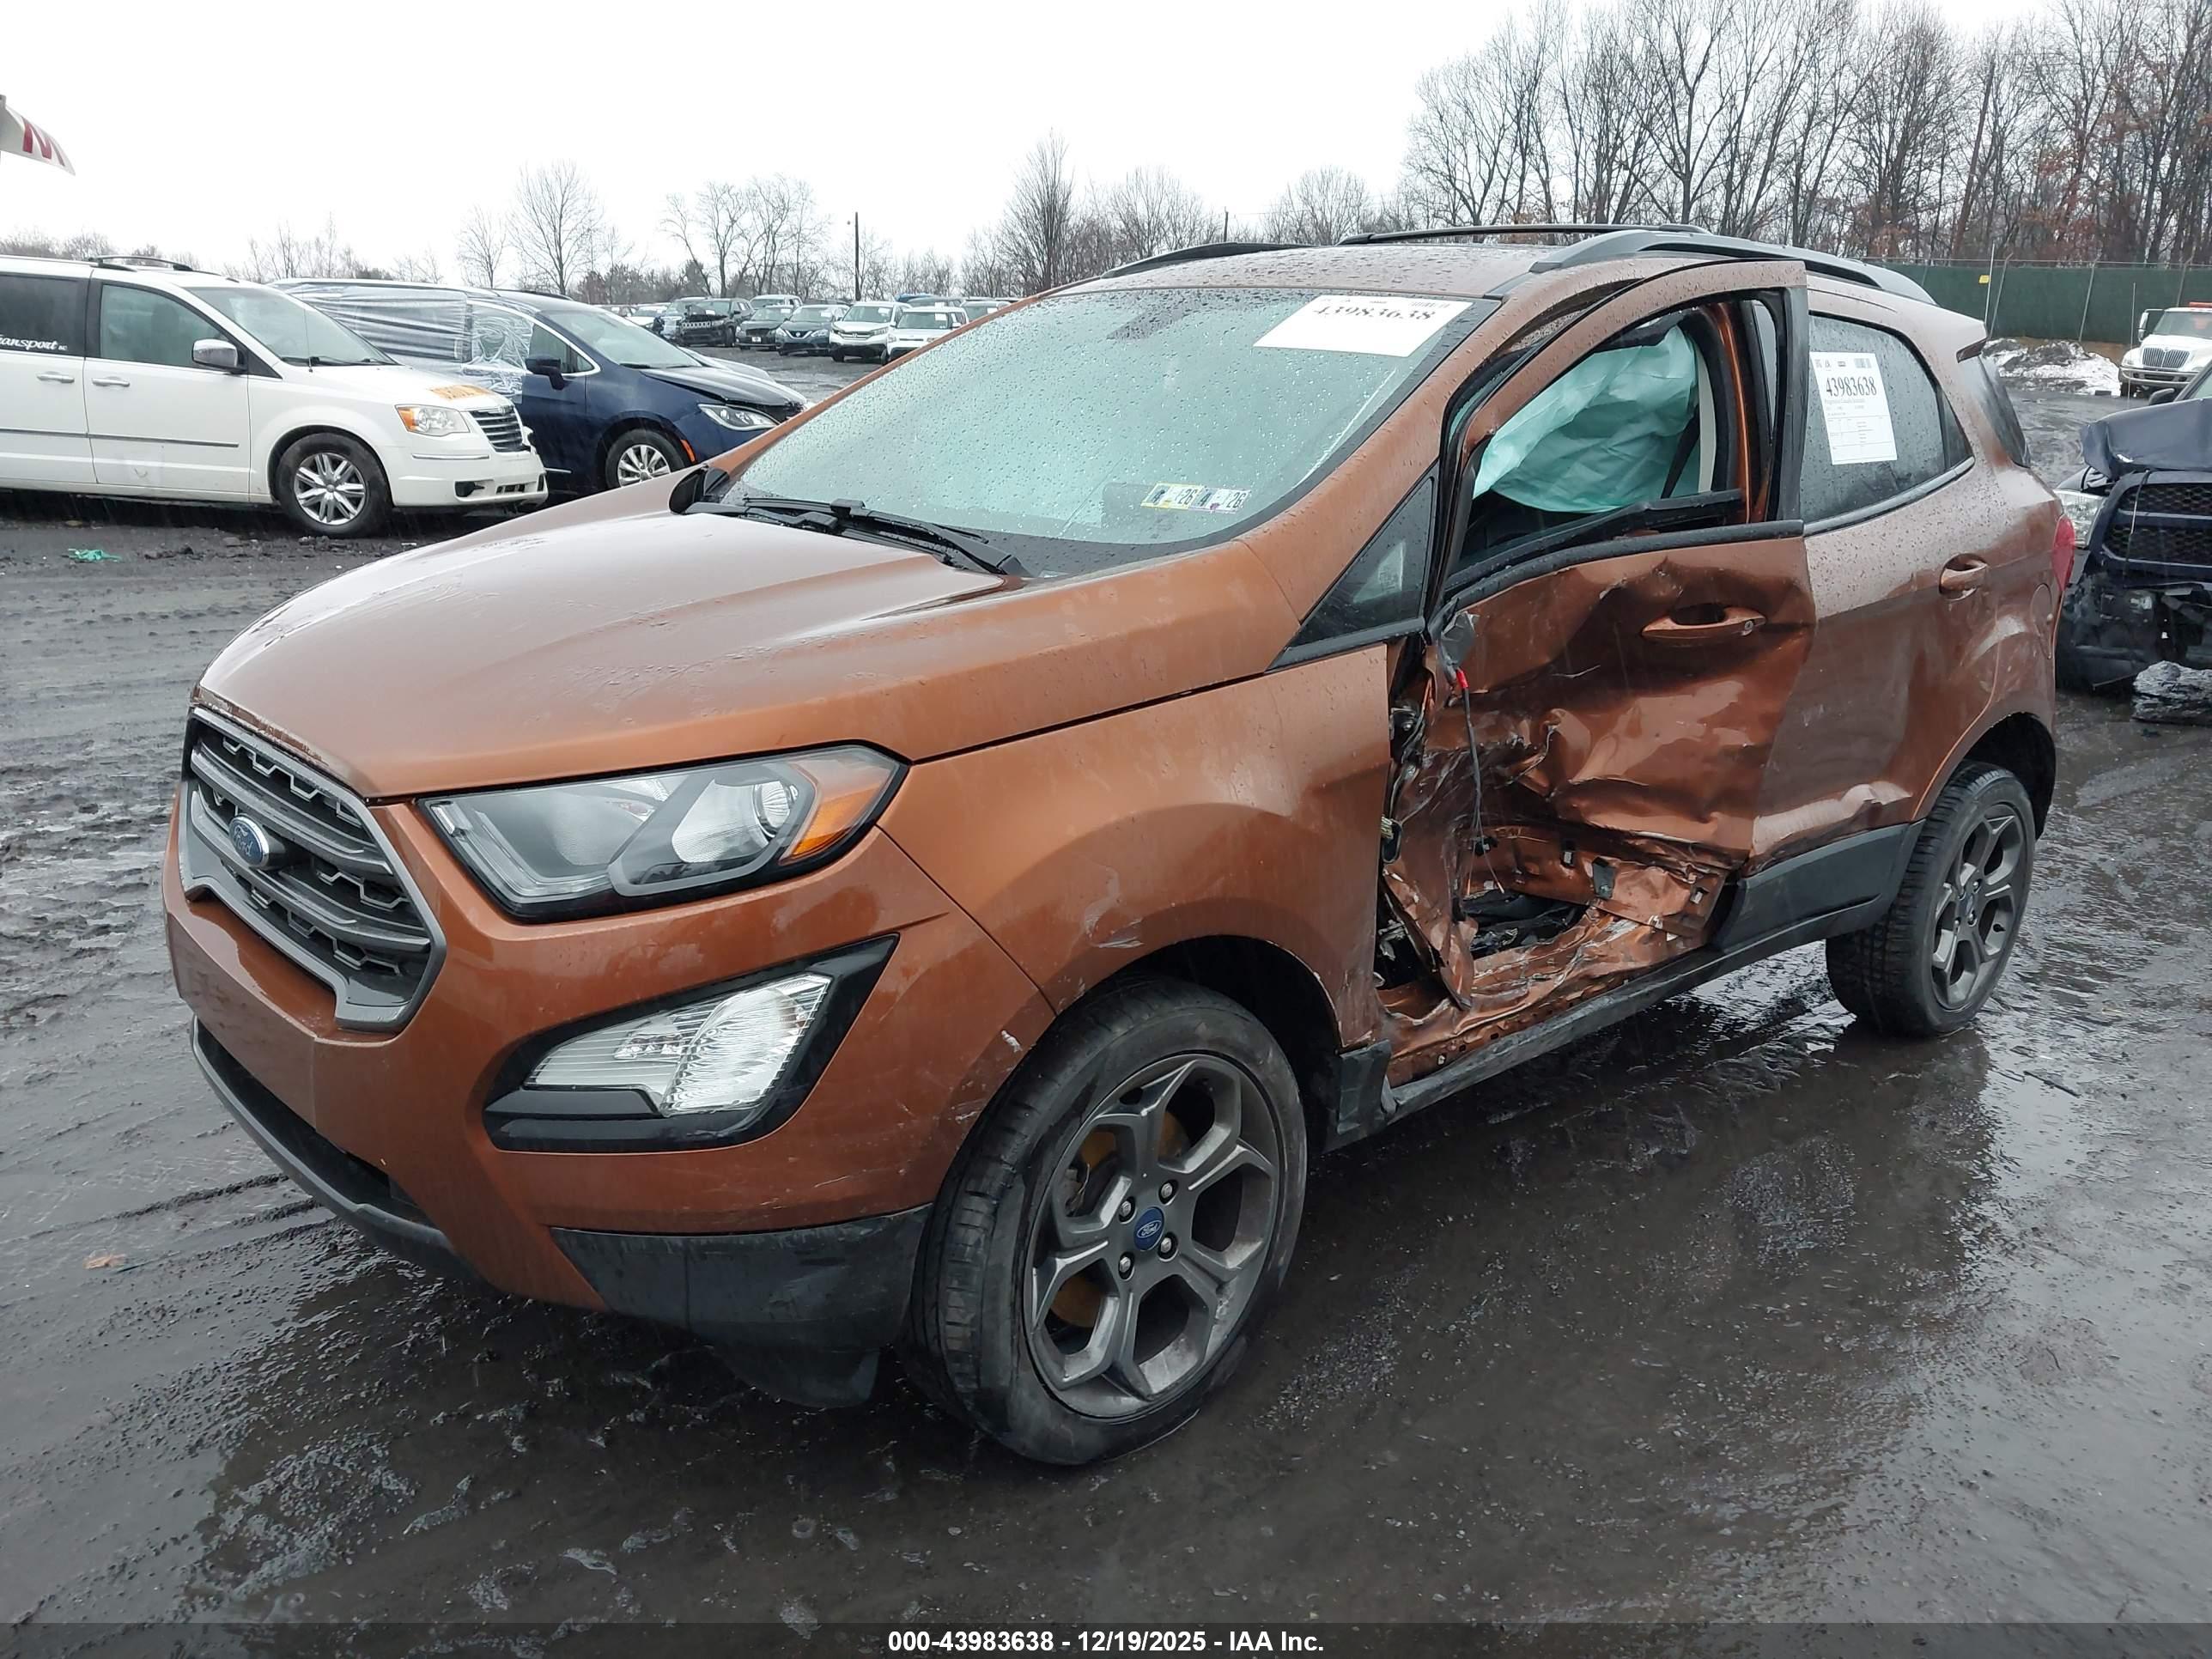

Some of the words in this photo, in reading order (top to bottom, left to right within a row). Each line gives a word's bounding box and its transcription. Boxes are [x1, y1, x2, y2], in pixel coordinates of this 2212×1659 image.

[1314, 305, 1437, 320] 43983638
[1826, 376, 1877, 397] 43983638
[1226, 491, 1247, 508] 26
